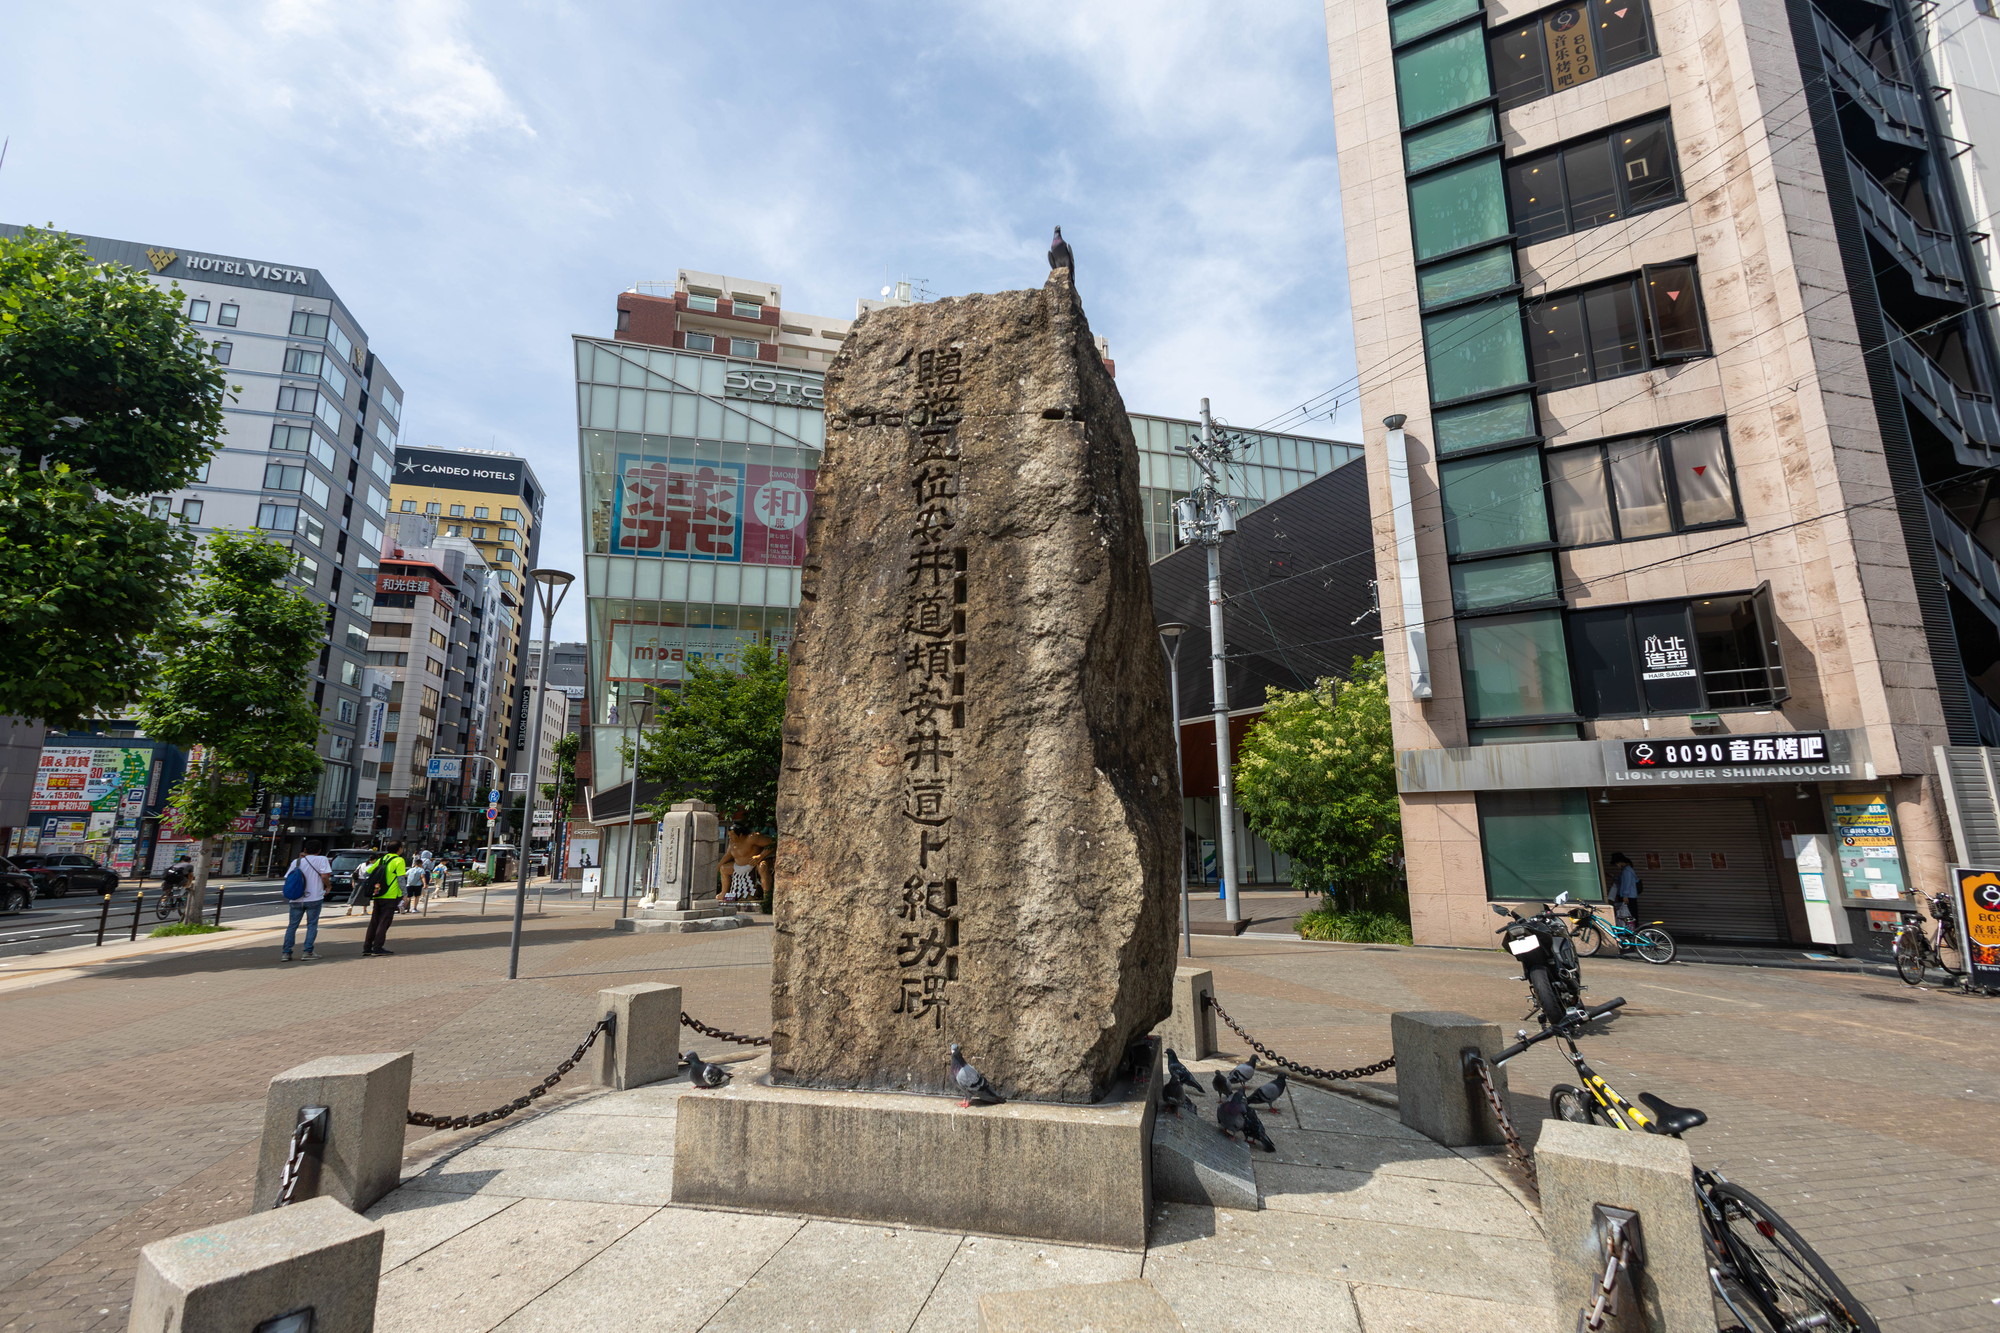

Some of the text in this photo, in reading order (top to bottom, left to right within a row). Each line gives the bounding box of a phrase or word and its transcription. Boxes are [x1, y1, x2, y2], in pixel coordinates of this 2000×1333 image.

[1552, 35, 1575, 87] 音乐烤吧
[1573, 34, 1590, 75] 8090
[186, 254, 308, 286] HOTEL VISTA
[762, 394, 814, 407] PLAZA
[421, 463, 516, 482] CANDEO HOTELS
[769, 470, 800, 479] KIMONO
[382, 578, 431, 593] 和光住建
[1644, 650, 1689, 668] 造型
[1665, 670, 1690, 678] SALON
[517, 689, 530, 748] CANDEO HOTELS
[1666, 744, 1723, 763] 8090
[1728, 736, 1824, 762] 音乐烤吧
[90, 767, 103, 779] 30
[1615, 764, 1850, 781] LION TOWER SHIMANOUCHI
[1975, 923, 2000, 935] 音乐
